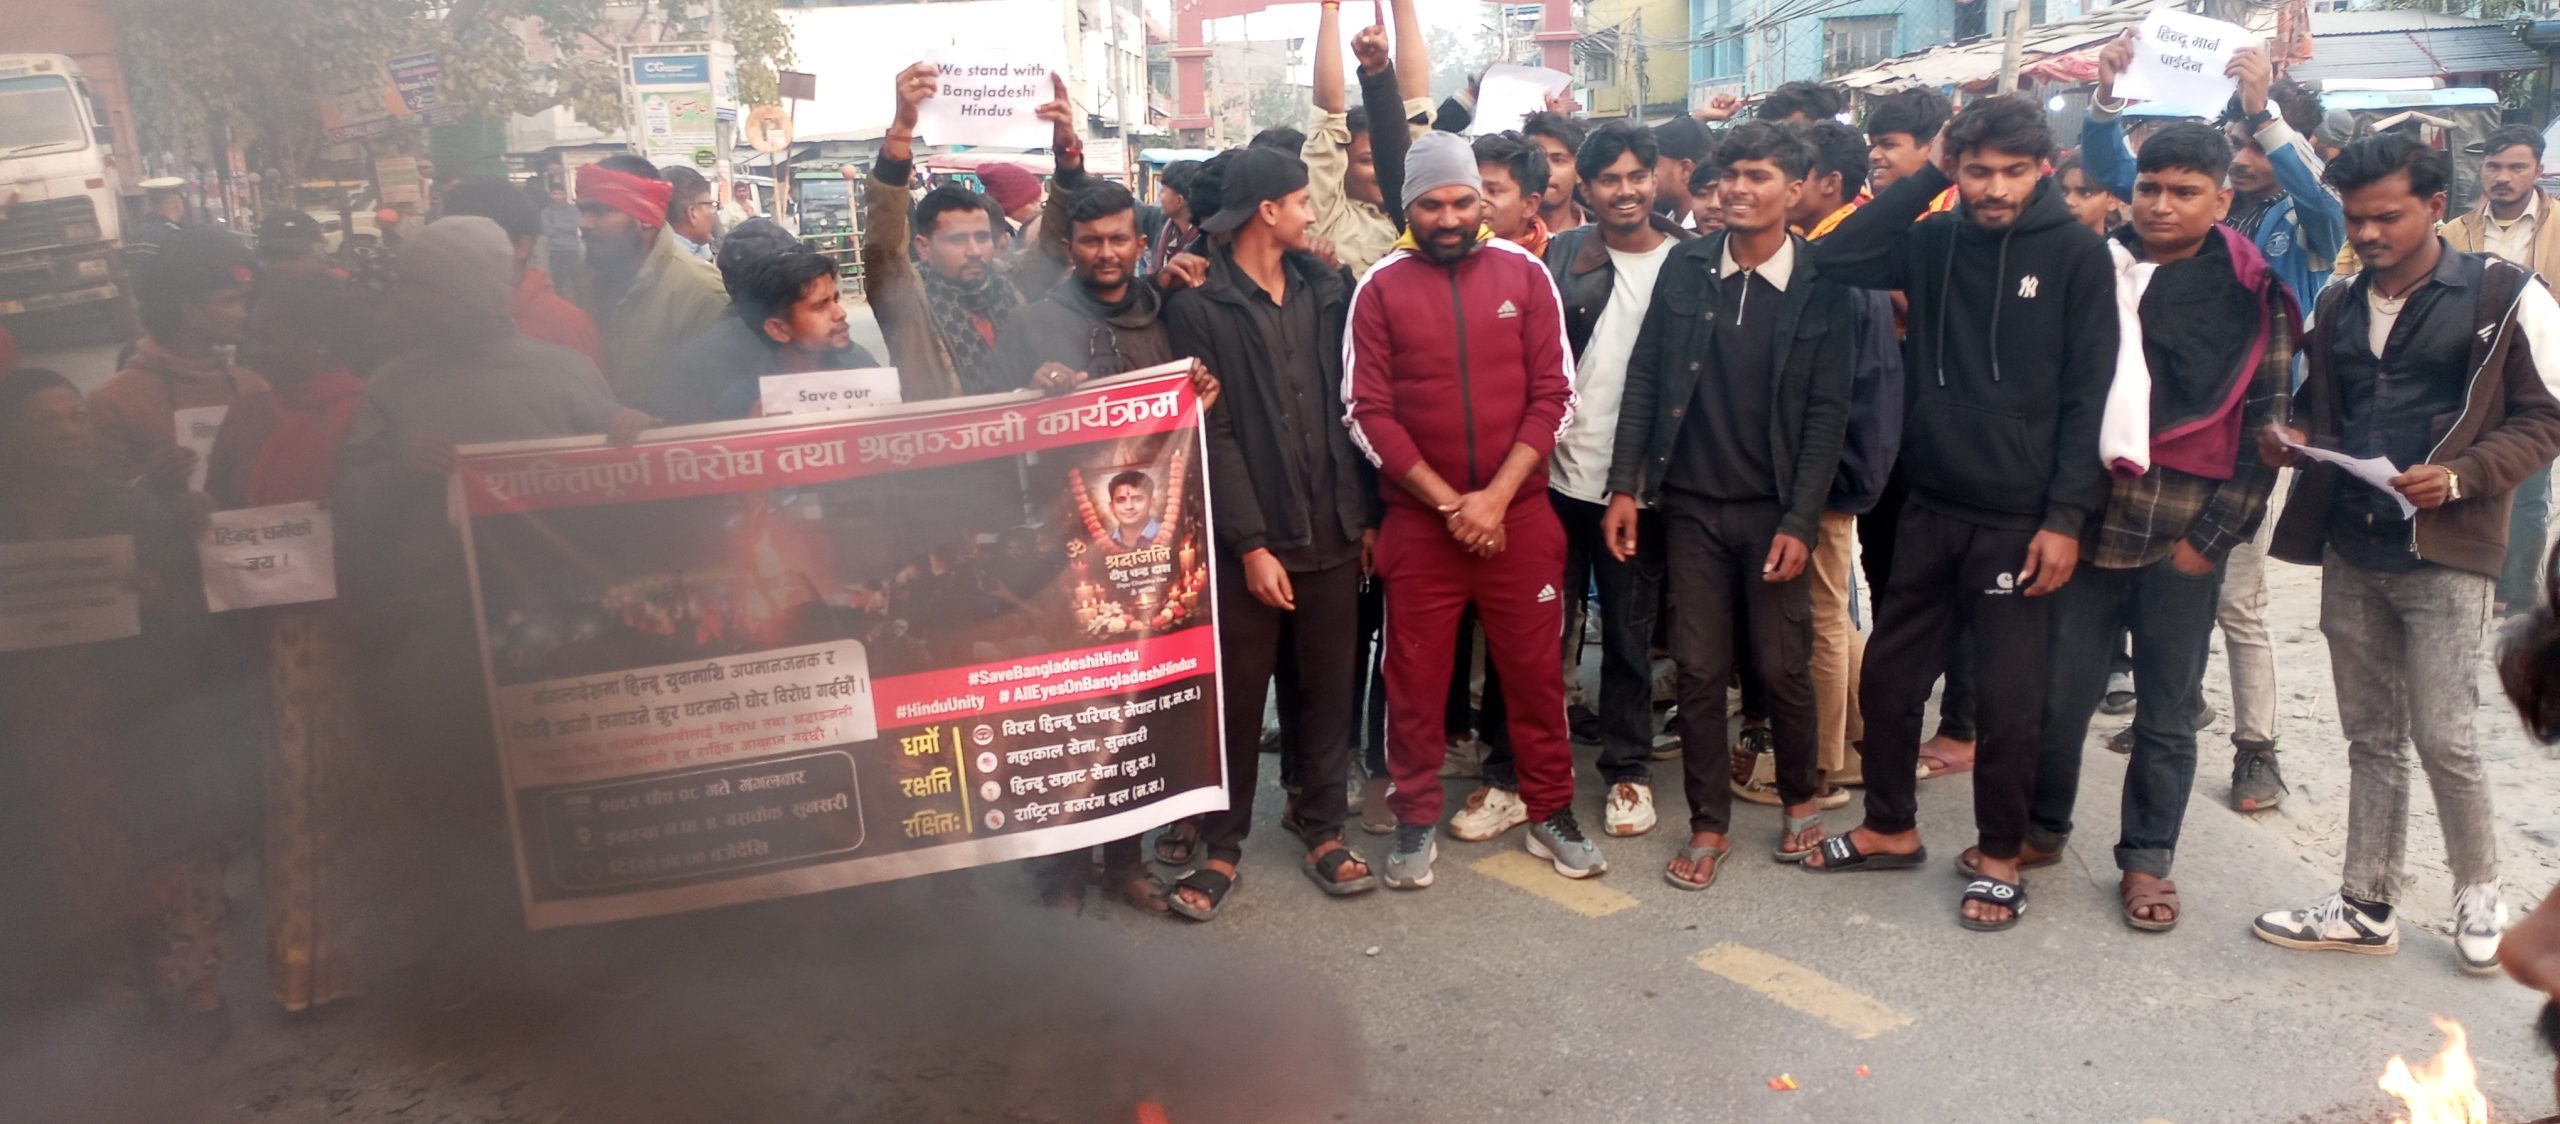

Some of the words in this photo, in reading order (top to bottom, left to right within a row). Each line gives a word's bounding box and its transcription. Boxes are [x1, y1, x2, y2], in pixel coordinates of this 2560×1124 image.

[2156, 24, 2190, 49] हिन्दू
[643, 62, 665, 73] CG
[936, 63, 963, 77] We
[967, 62, 1009, 77] stand
[1013, 63, 1046, 77] with
[942, 84, 1036, 101] Bangladeshi
[960, 103, 1014, 118] Hindus
[797, 389, 839, 403] Save
[843, 388, 872, 400] our
[776, 438, 847, 476] तथा
[1035, 388, 1181, 438] कार्यक्रम
[243, 554, 276, 571] जय
[623, 673, 663, 697] हिन्दू
[729, 652, 821, 679] अपमानजनक
[824, 650, 837, 666] र
[967, 648, 1141, 687] #SaveBangladeshiHindu
[895, 692, 987, 721] #HinduUnity
[1012, 655, 1200, 703] AllEyesOnBangladeshiHindus
[596, 704, 651, 730] लगाउने
[683, 692, 741, 718] घटनाको
[773, 683, 812, 705] विरोध
[1001, 718, 1037, 739] विश्व
[1038, 713, 1077, 734] हिन्दू
[1123, 699, 1158, 719] नेपाल
[1005, 744, 1065, 767] महाकाल
[1103, 726, 1150, 755] सुनसरी
[899, 764, 953, 800] रक्षति
[1009, 774, 1050, 797] हिन्दू
[1048, 768, 1088, 790] सम्राट
[1090, 761, 1119, 781] सेना
[1107, 786, 1130, 807] दल
